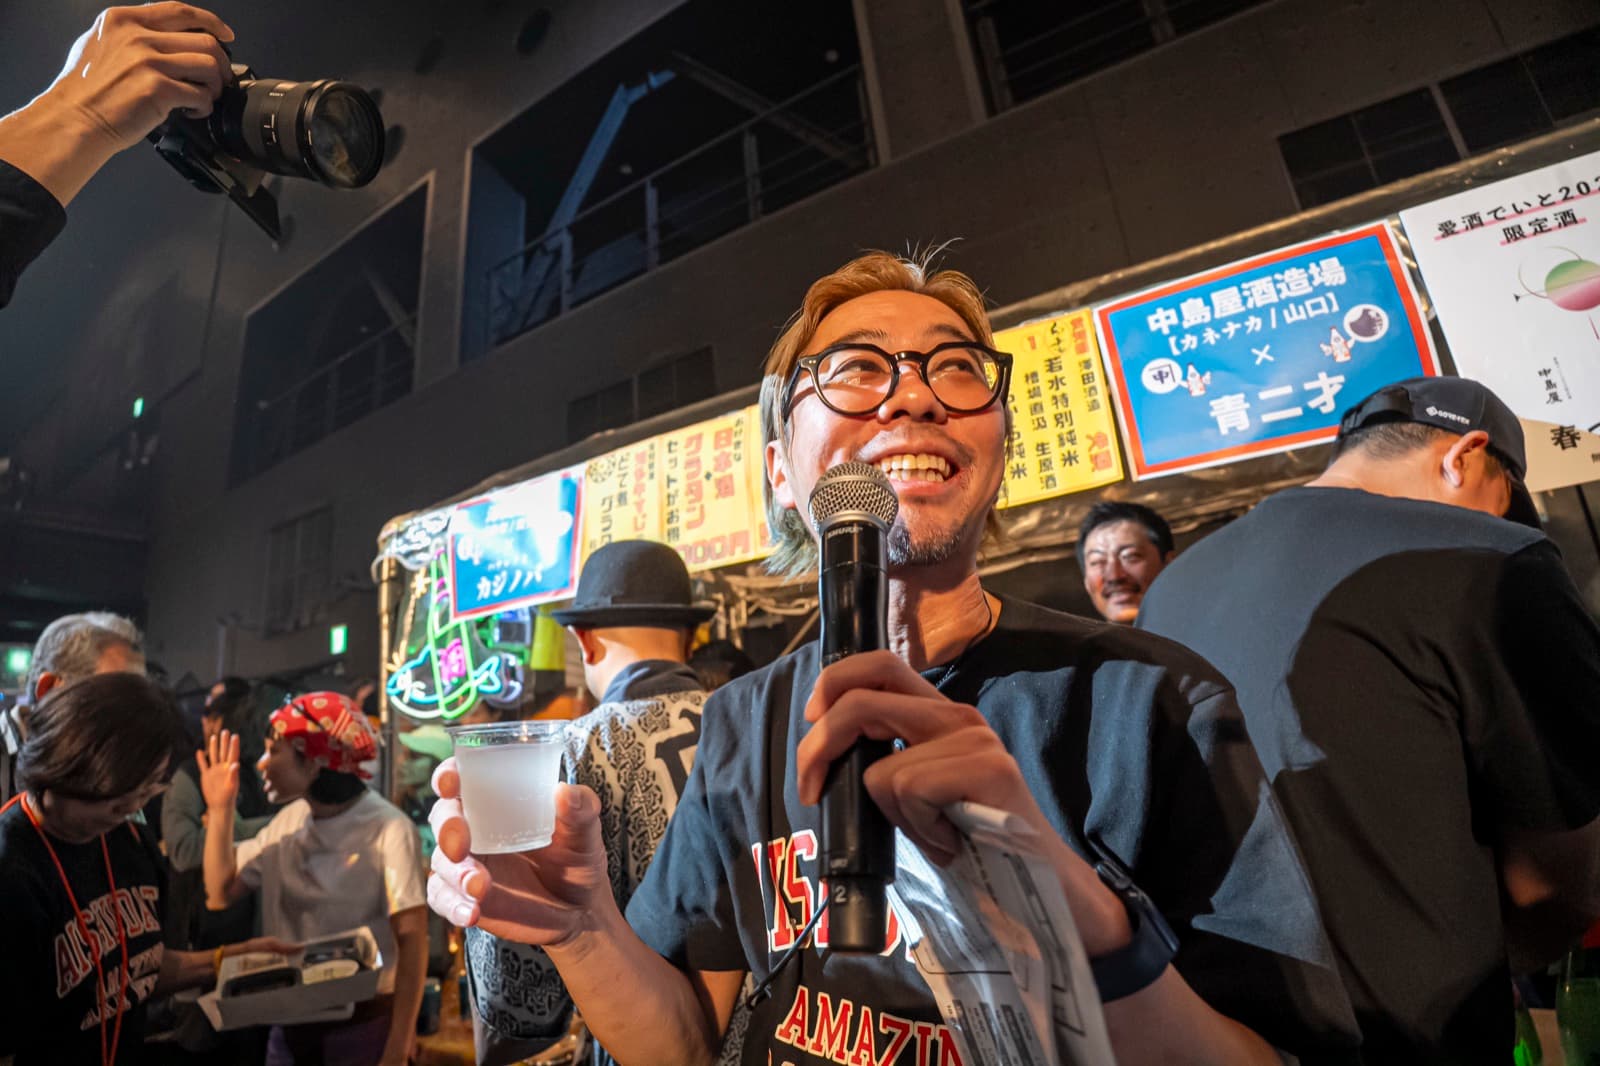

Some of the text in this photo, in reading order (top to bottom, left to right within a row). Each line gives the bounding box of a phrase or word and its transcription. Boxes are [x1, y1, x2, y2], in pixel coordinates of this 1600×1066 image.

[1502, 208, 1579, 243] 限定酒
[1146, 256, 1347, 336] 中島屋酒造場
[1209, 372, 1346, 436] 青二才
[1550, 425, 1581, 451] 春
[835, 885, 848, 904] 2
